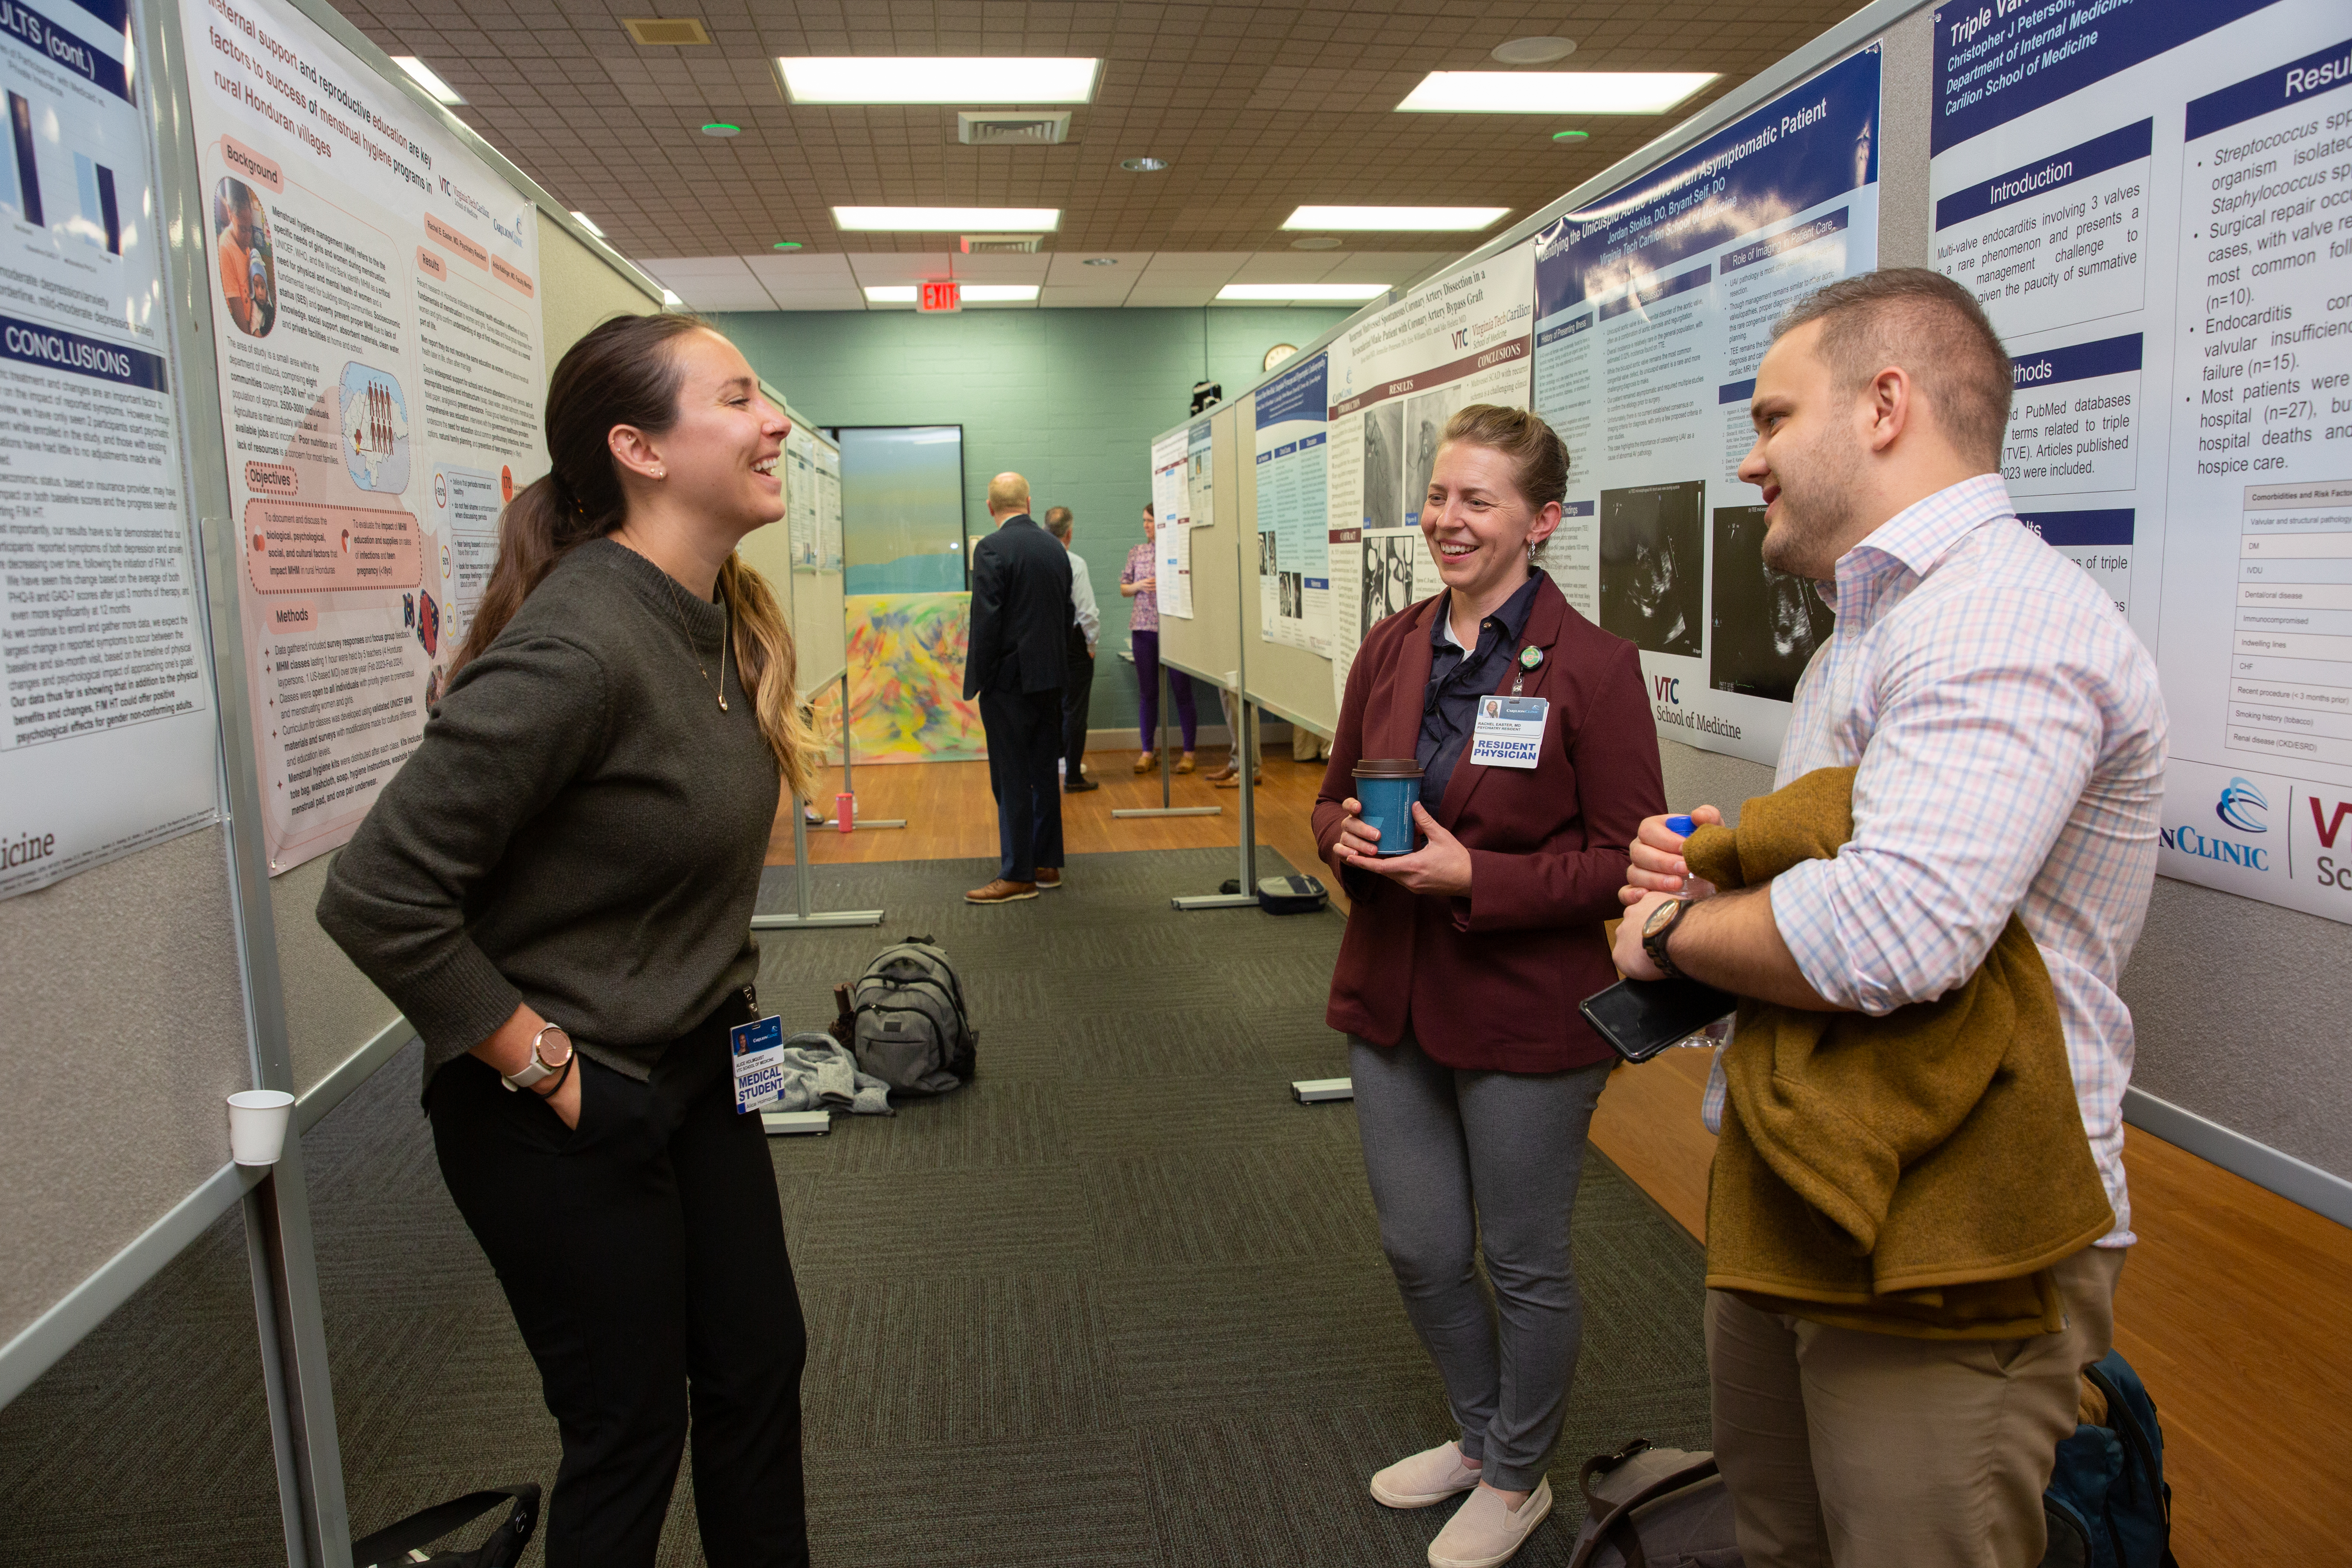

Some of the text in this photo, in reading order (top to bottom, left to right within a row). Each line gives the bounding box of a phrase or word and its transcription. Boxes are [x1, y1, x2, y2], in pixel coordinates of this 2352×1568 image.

[1951, 9, 1991, 47] Triple
[1946, 53, 2004, 94] Department
[2006, 42, 2019, 62] of
[2020, 18, 2066, 55] Internal
[2069, 0, 2133, 30] Medicin,
[1948, 31, 2005, 71] Christopher
[2008, 22, 2014, 38] J
[1946, 32, 2098, 115] Carilion School of Medicine
[209, 27, 432, 194] factors to success of menstrual hygiene programs in
[214, 71, 331, 157] rural Honduran villages
[259, 31, 298, 69] support
[300, 62, 316, 83] and
[319, 76, 370, 122] reproductive
[372, 116, 407, 148] education
[409, 142, 419, 158] are
[421, 147, 431, 170] key
[2214, 122, 2318, 165] Streptococcus
[227, 145, 277, 183] Background
[1570, 229, 1580, 245] the
[1699, 127, 1777, 182] Asymptomatic
[1781, 97, 1827, 138] Patient
[439, 175, 451, 197] VTC
[1991, 162, 2072, 203] Introduction
[1608, 227, 1628, 244] Jordan
[1629, 216, 1653, 233] Stokka,
[1654, 206, 1666, 223] DO,
[1669, 194, 1692, 221] Bryant
[1694, 184, 1710, 208] Self,
[1713, 177, 1725, 199] DO
[1938, 185, 2140, 259] Multi-valve endocarditis involving 3 valves
[2210, 198, 2315, 238] Surgical repair
[272, 206, 296, 225] Menstrual
[297, 218, 315, 235] hygiene
[316, 230, 343, 246] management
[343, 242, 356, 257] (MHM)
[357, 251, 368, 261] refers
[1600, 196, 1737, 266] Virginia Tech Carilion School of Medicine
[1733, 221, 1832, 266] Role of Imaging in Patient Care
[423, 254, 439, 271] Results
[922, 283, 956, 310] EXIT
[1406, 271, 1486, 312] Coronary Artery Dissection in a
[1639, 287, 1662, 304] Discussion
[1408, 289, 1483, 329] Coronary Artery Bypass Graft
[1472, 305, 1531, 336] Virginia Tech Carilion
[2206, 305, 2291, 334] Endocarditis
[5, 325, 131, 378] CONCLUSIONS
[1452, 327, 1468, 350] VTC
[1477, 343, 1521, 368] CONCLUSIONS
[2013, 359, 2052, 383] thods
[2203, 354, 2298, 381] failure (n=15).
[1388, 379, 1414, 395] RESULTS
[2026, 395, 2130, 418] PubMed databases
[250, 469, 290, 487] Objectives
[277, 609, 308, 622] Methods
[1654, 675, 1679, 704] VTC
[1657, 705, 1741, 740] School of Medicine
[1474, 749, 1536, 760] PHYSICIAN
[1478, 740, 1535, 751] RESIDENT
[746, 1054, 764, 1065] HOLMQUIST
[760, 1057, 774, 1066] MEDICINE
[739, 1066, 781, 1089] MEDICAL
[739, 1077, 783, 1102] STUDENT
[757, 1094, 777, 1105] Holmquist
